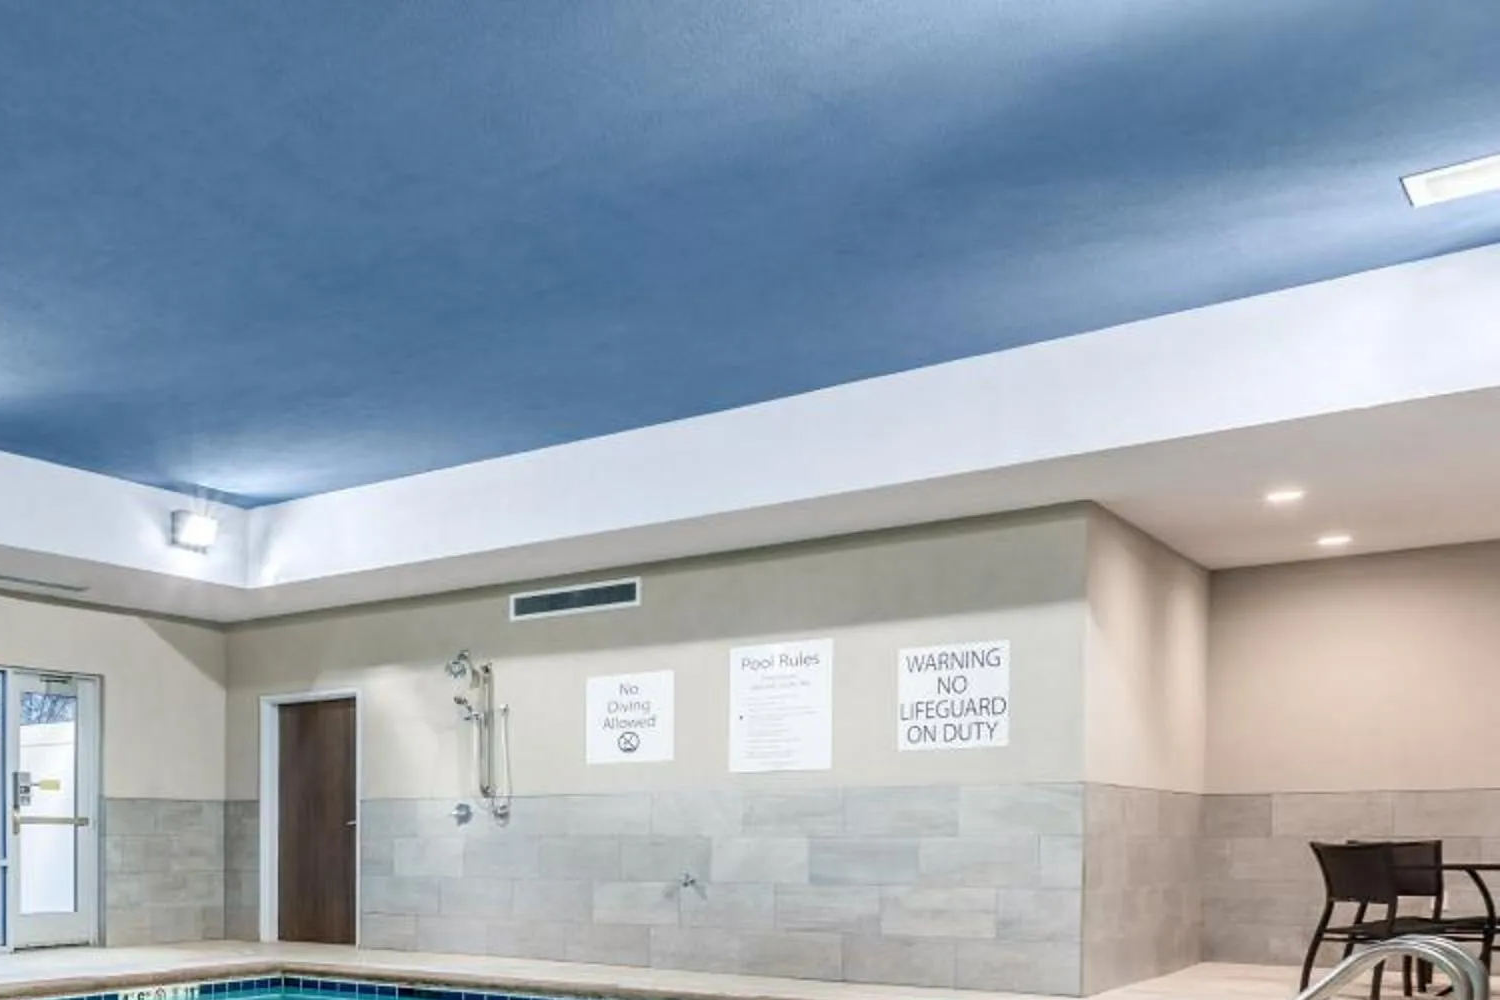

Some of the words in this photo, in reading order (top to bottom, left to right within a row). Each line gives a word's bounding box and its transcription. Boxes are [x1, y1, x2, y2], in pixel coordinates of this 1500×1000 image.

[741, 654, 775, 671] Pool
[779, 652, 820, 668] Rules
[906, 648, 1001, 673] WARNING
[619, 684, 639, 696] No
[937, 675, 968, 695] NO
[607, 701, 651, 715] Diving
[900, 696, 1007, 720] LIFEGUARD
[602, 714, 656, 730] Allowed
[907, 725, 937, 744] ON
[943, 721, 998, 743] DUTY
